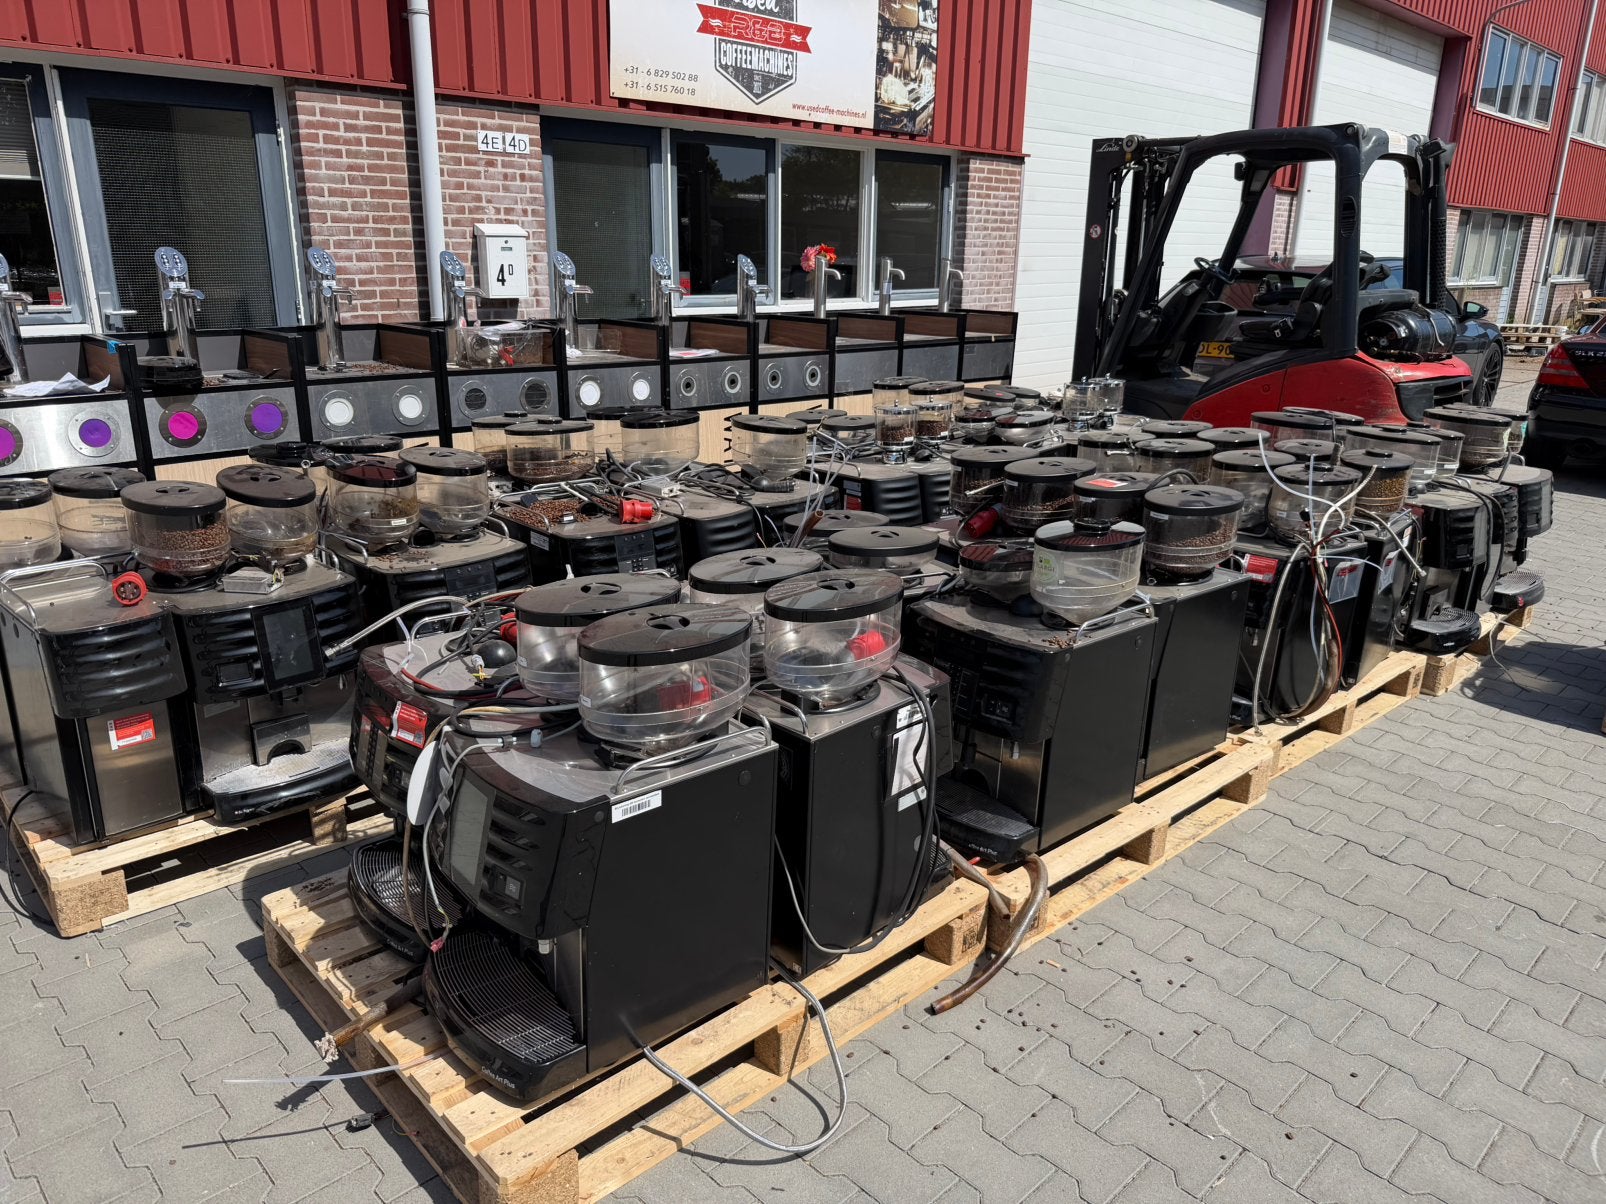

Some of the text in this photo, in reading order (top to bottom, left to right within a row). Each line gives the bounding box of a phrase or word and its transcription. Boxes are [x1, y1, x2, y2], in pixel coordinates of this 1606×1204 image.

[720, 42, 793, 76] COFFEEMACHINES
[623, 65, 639, 75] +31
[646, 68, 652, 76] 6
[653, 69, 670, 78] 829
[671, 71, 687, 81] 502
[687, 73, 699, 83] 88
[623, 80, 639, 89] +31
[646, 82, 652, 91] 6
[653, 83, 668, 93] 515
[670, 85, 685, 95] 760
[687, 88, 696, 96] 18
[481, 132, 500, 150] 4E
[508, 135, 527, 152] 4D
